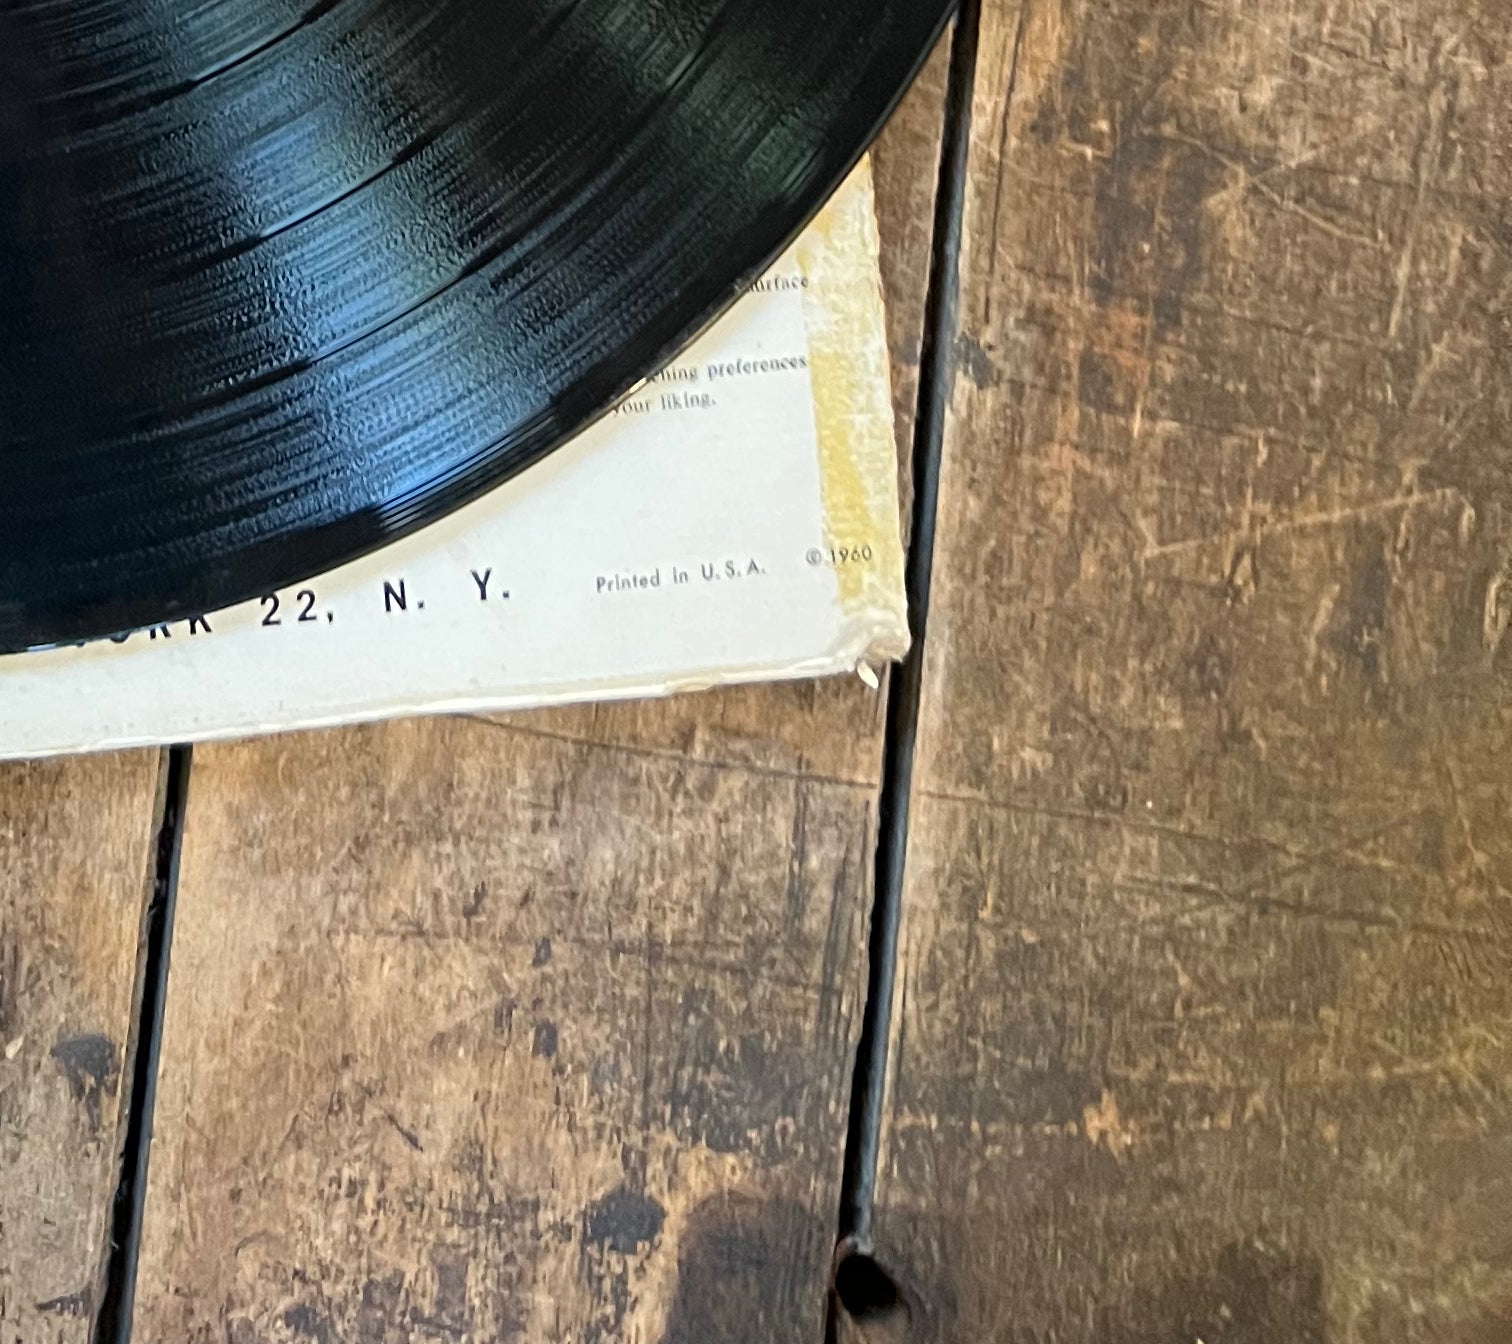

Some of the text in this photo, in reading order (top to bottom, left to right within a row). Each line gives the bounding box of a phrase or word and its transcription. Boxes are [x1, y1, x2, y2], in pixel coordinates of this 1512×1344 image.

[830, 544, 873, 564] 1960
[596, 568, 661, 593] Printed
[672, 566, 689, 584] in
[260, 590, 334, 627] 22,
[383, 579, 426, 613] N.
[469, 567, 510, 601] Y.
